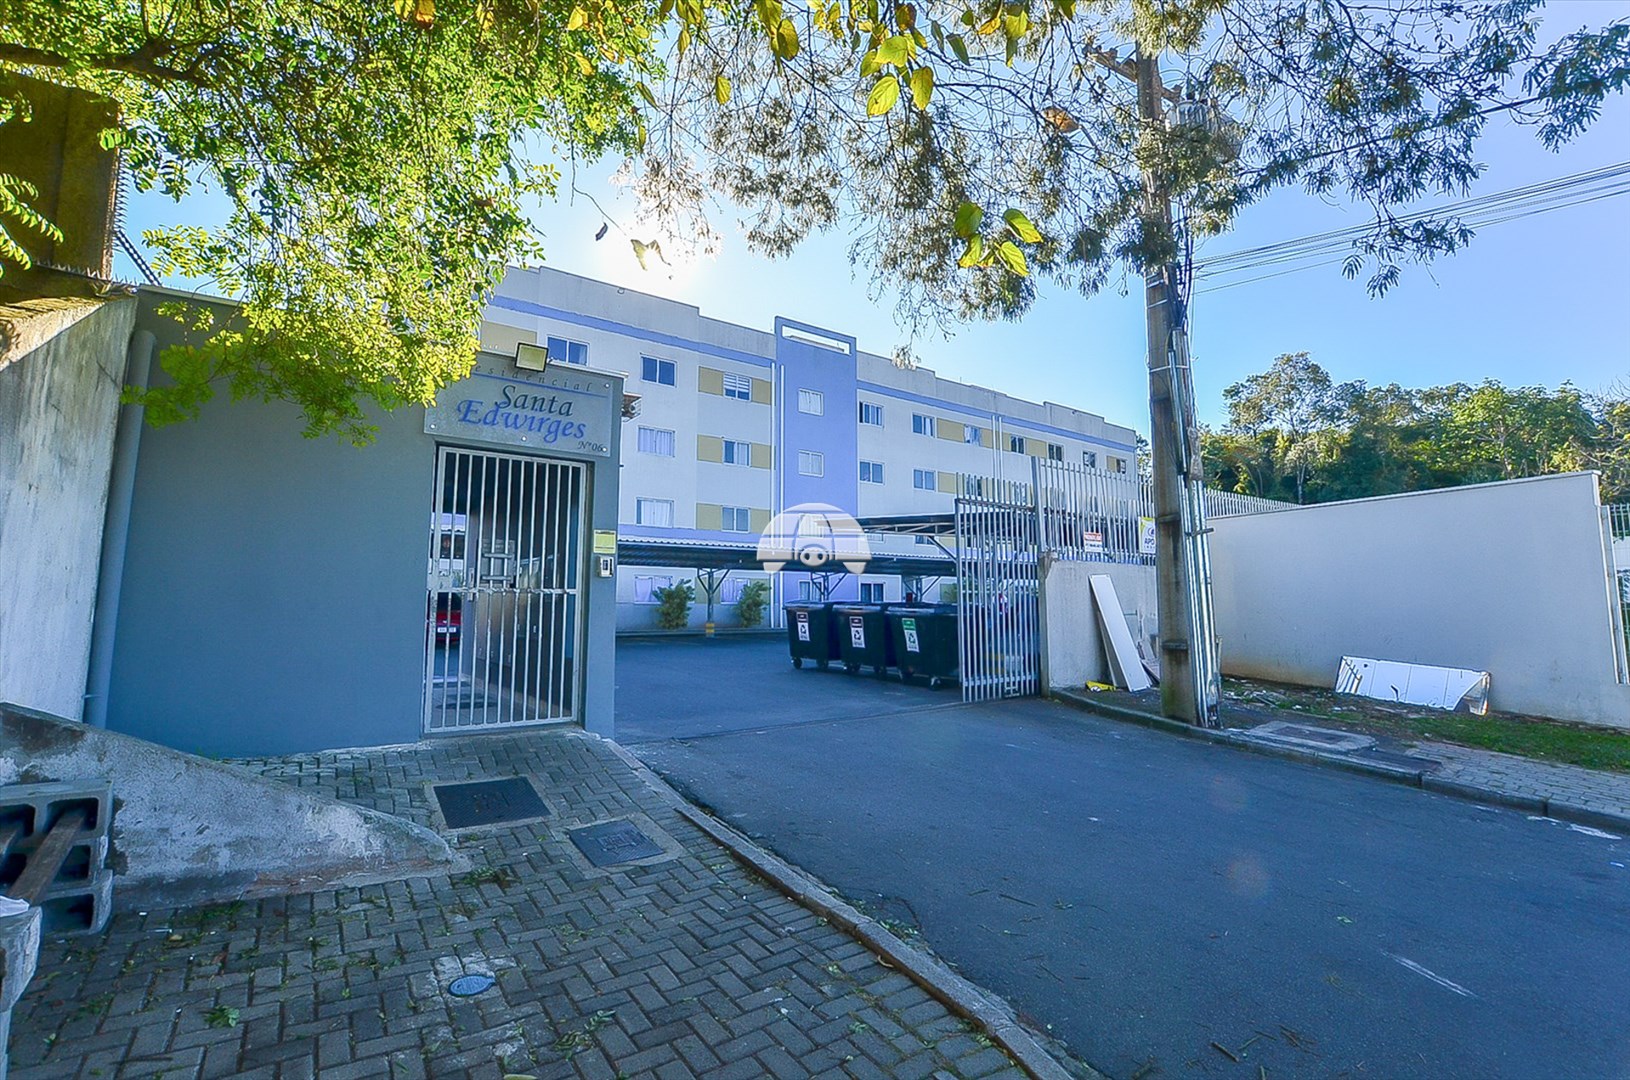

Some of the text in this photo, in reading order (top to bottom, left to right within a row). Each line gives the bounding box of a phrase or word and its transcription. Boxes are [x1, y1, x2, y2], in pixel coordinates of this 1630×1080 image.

[475, 364, 592, 391] esidencial
[494, 384, 574, 417] Santa
[457, 399, 587, 444] Edwirges
